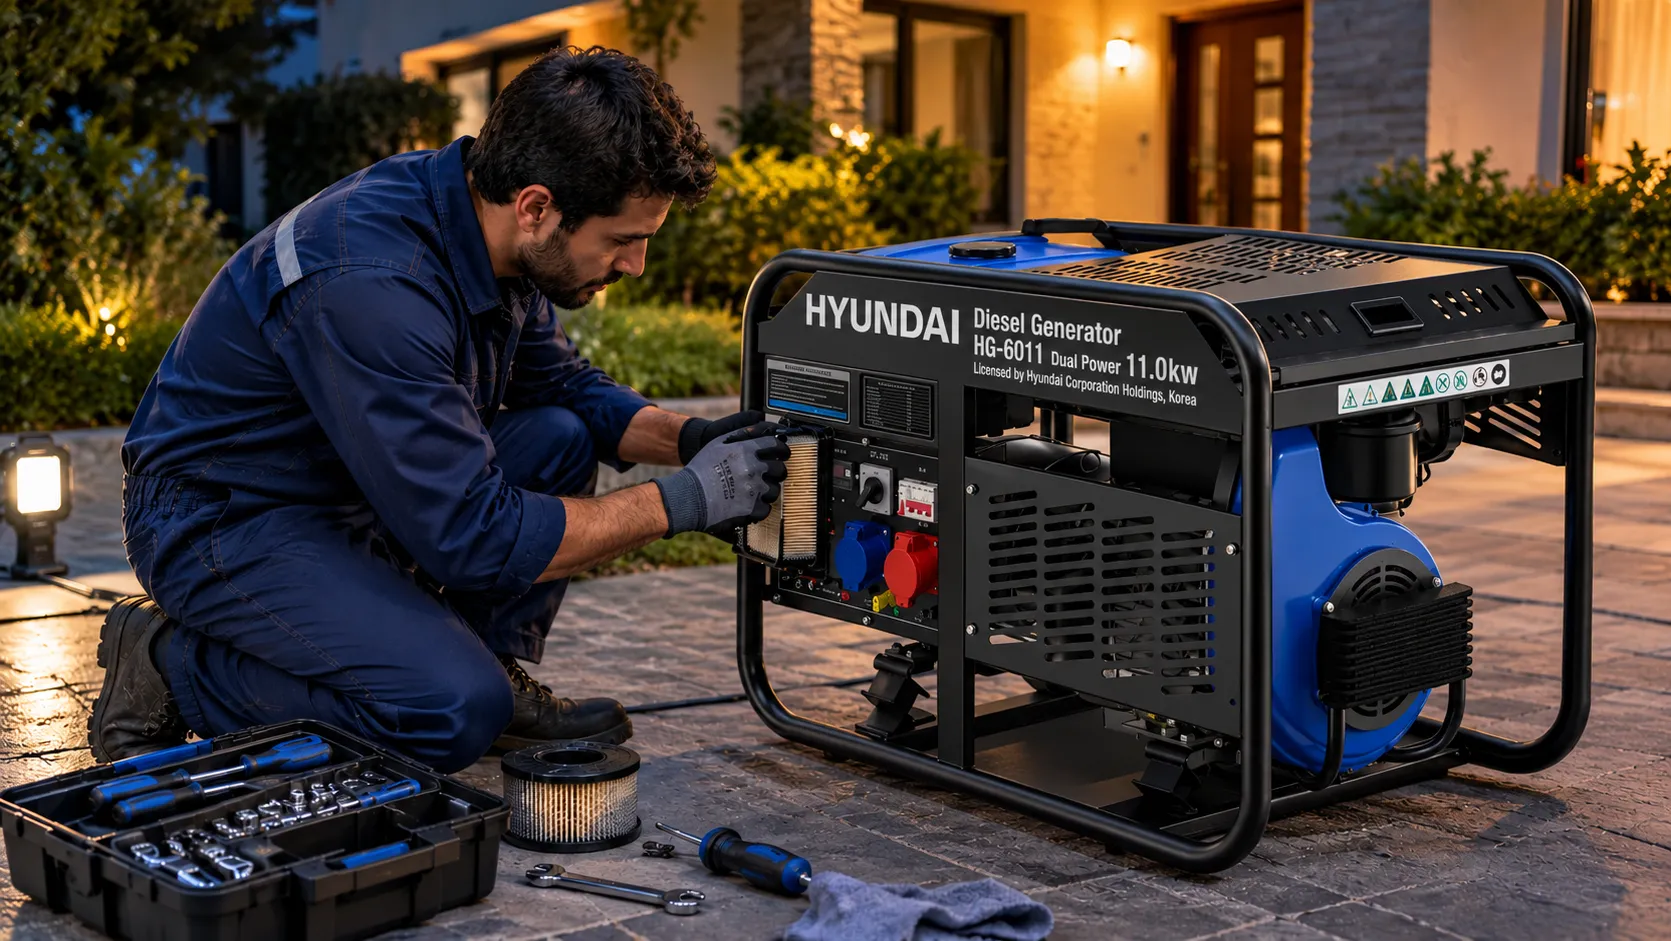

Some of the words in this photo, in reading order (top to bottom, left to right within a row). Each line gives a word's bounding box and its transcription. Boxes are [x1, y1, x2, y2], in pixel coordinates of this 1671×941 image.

[805, 292, 961, 345] HYUNDAI
[973, 307, 1026, 335] Diesel
[1030, 313, 1122, 347] Generator
[973, 334, 1043, 366] HG-6011
[1051, 350, 1078, 370] Dual
[1081, 354, 1122, 376] Power
[1126, 352, 1199, 386] 11.0kw
[973, 361, 1012, 379] Licensed
[1013, 367, 1025, 384] by
[1026, 369, 1064, 388] Hyundai
[1065, 374, 1120, 396] Corporation
[1122, 382, 1166, 406] Holdings,
[1168, 389, 1198, 407] Korea
